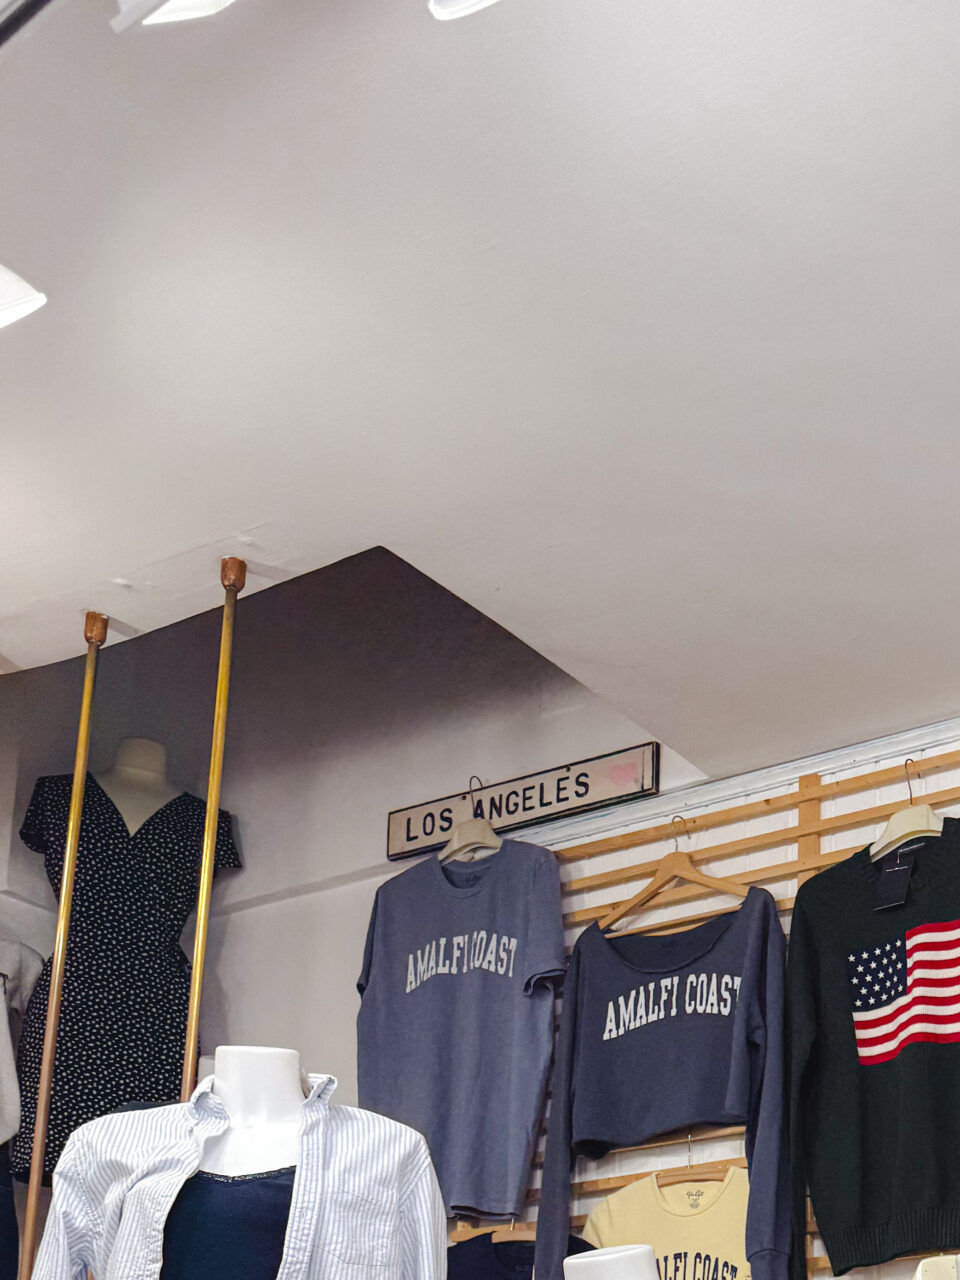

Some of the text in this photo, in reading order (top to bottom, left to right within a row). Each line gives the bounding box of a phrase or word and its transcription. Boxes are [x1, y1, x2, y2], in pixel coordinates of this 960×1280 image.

[405, 772, 590, 842] LOS ANGELES
[405, 930, 518, 994] AMALFI COAST
[602, 975, 680, 1041] AMALFI
